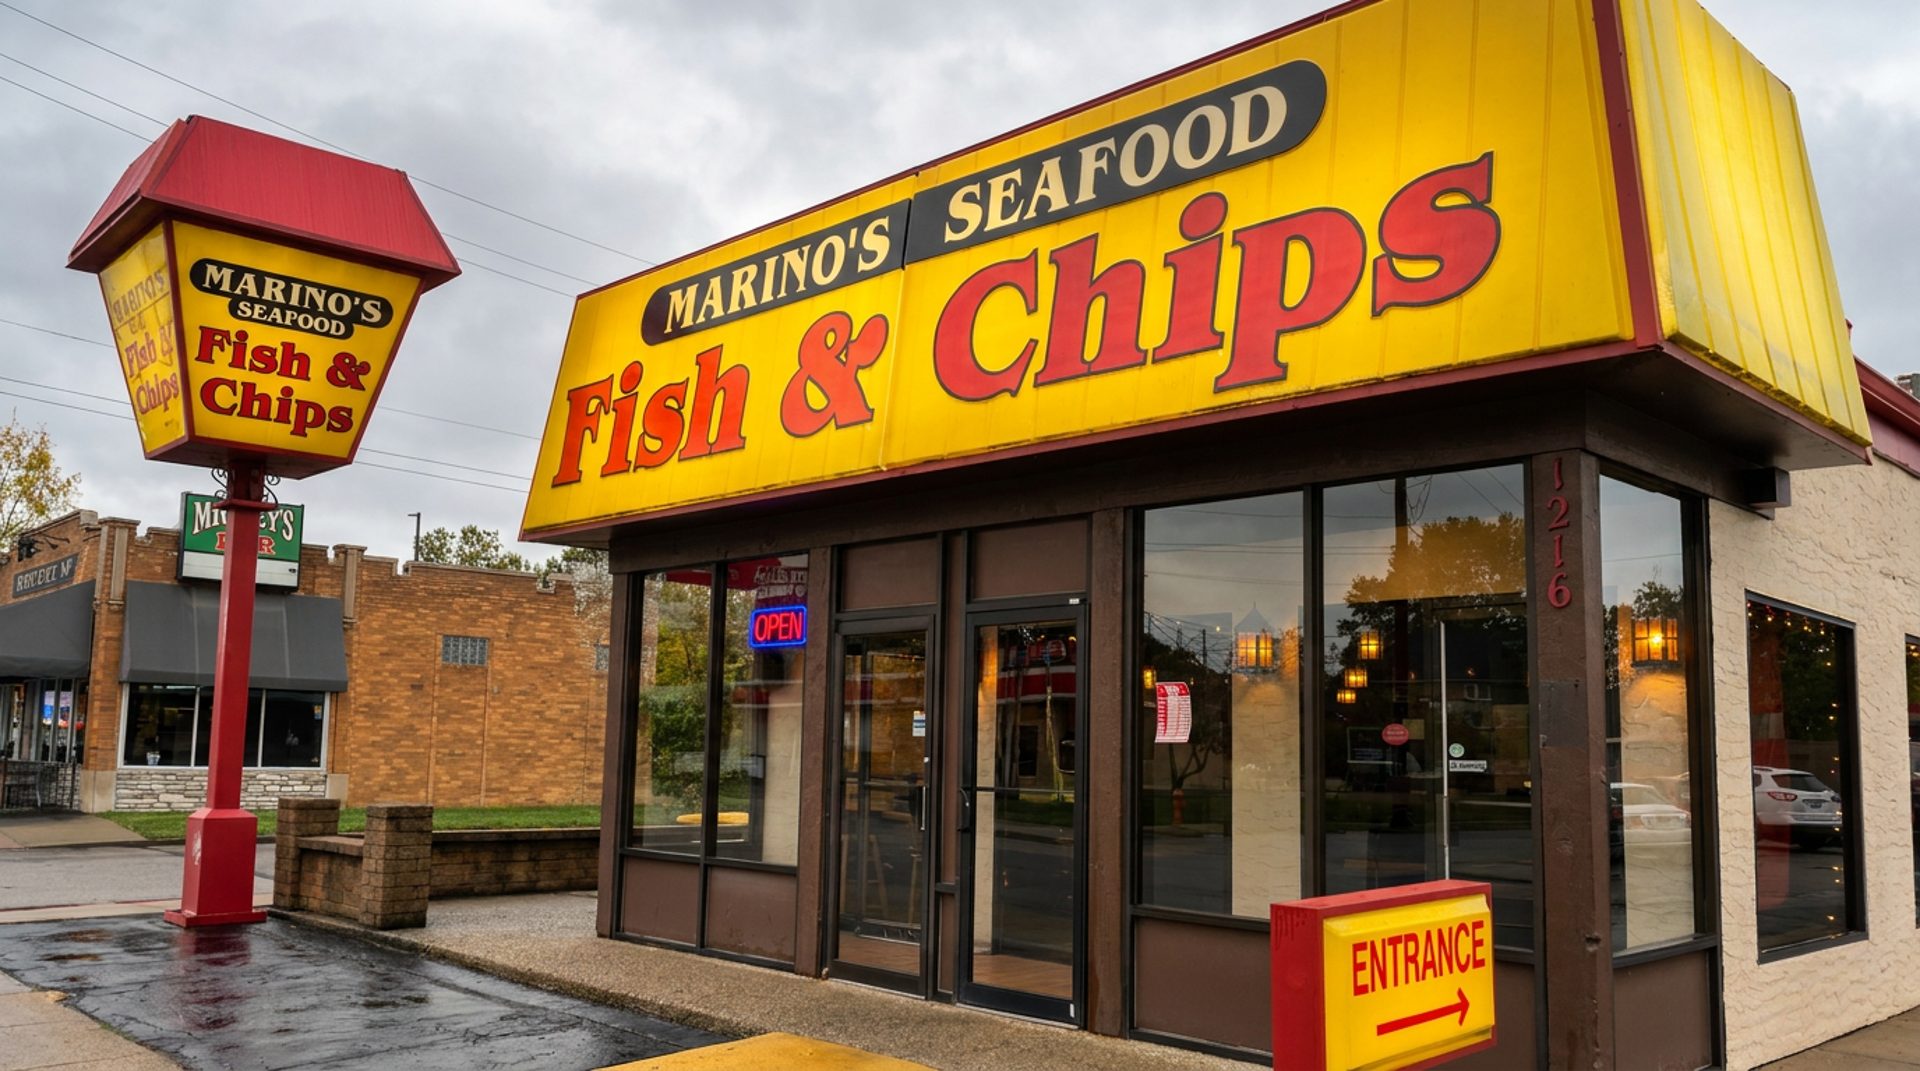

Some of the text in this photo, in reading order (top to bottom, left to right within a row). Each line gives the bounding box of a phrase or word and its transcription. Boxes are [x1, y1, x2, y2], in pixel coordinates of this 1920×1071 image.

[664, 85, 1288, 334] MARINO'S SEAFOOD
[202, 263, 382, 323] MARINO'S
[551, 150, 1500, 488] Fish & Chips
[195, 325, 311, 382] Fish
[326, 351, 371, 392] &
[200, 376, 354, 438] Chips
[1546, 457, 1572, 609] 1216
[754, 612, 803, 642] OPEN
[1352, 920, 1486, 997] ENTRANCE
